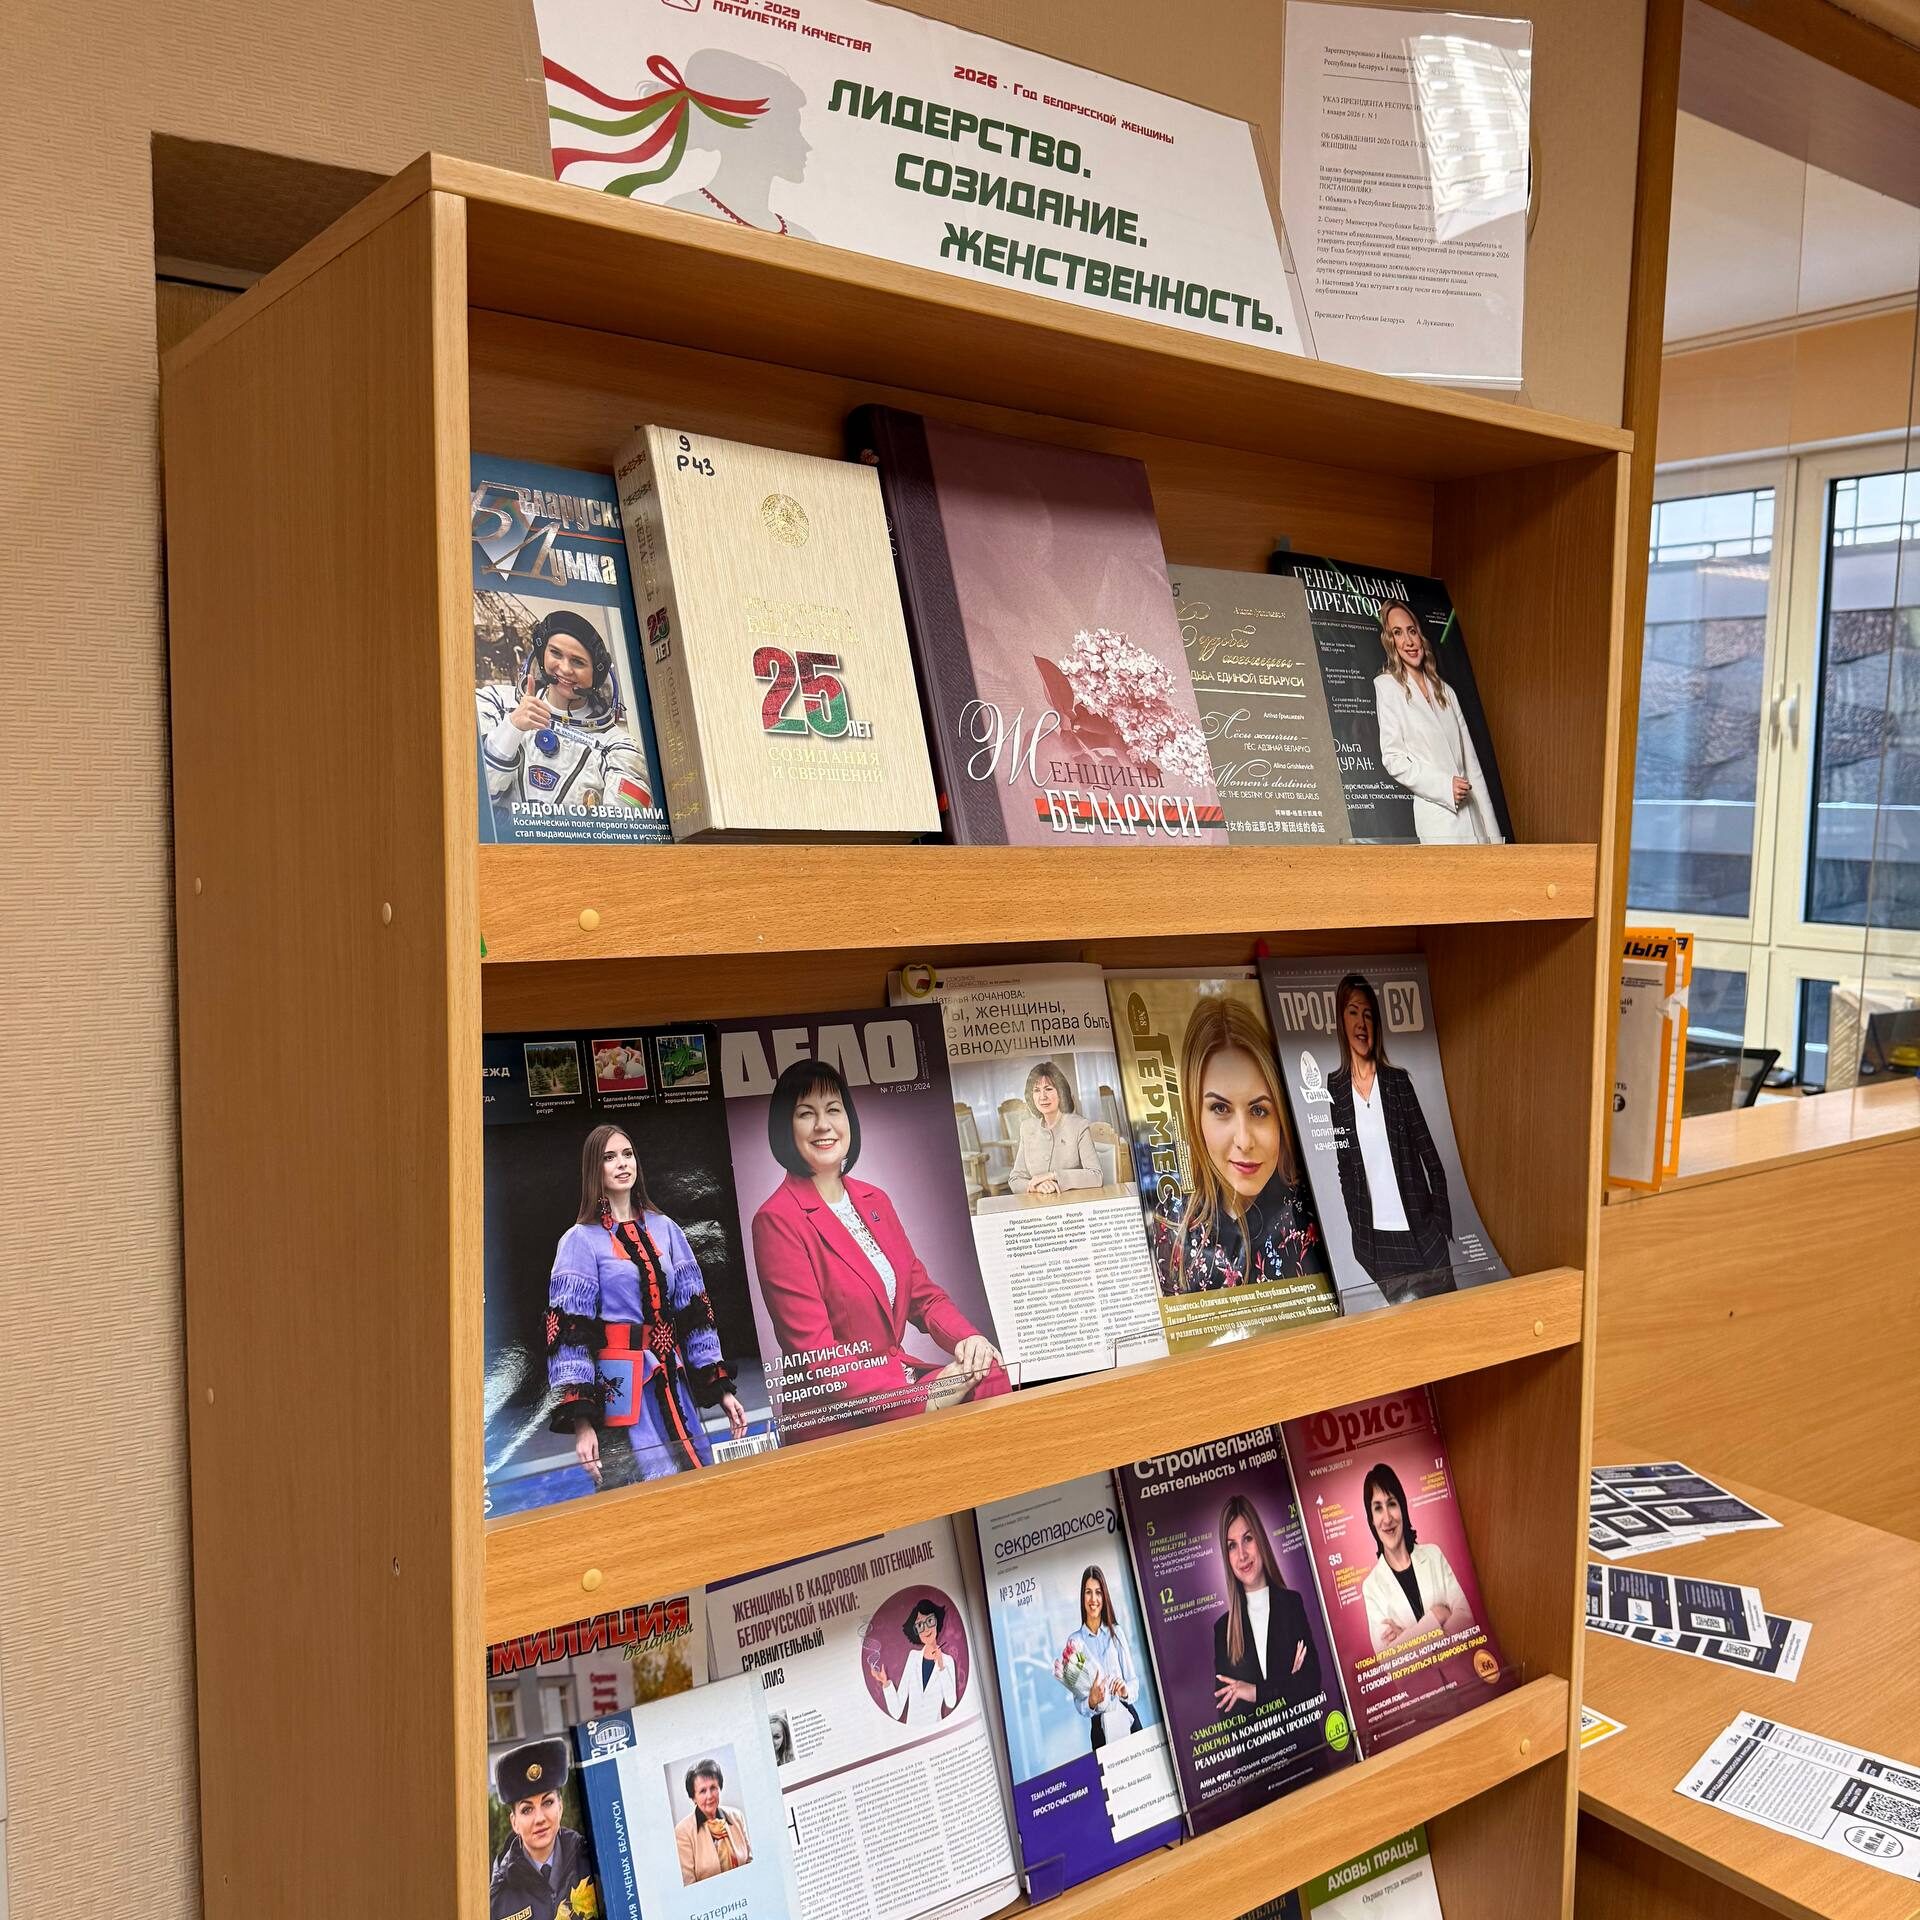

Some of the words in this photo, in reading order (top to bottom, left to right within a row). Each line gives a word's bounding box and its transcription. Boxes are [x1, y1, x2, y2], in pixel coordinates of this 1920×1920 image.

[763, 1, 800, 19] 2029
[713, 0, 797, 32] ПЯТИЛЕТКА
[801, 24, 872, 53] КАЧЕСТВА
[953, 65, 998, 89] 2026
[1042, 95, 1117, 126] БЕЛОРУССКОЙ
[1121, 119, 1174, 145] ЖЕНЩИНЫ
[1322, 96, 1340, 104] УКАЗ
[1341, 98, 1383, 109] ПРЕЗИДЕНТА
[828, 78, 1091, 179] ЛИДЕРСТВО.
[1321, 132, 1333, 140] ОБ
[1377, 137, 1391, 145] 2026
[1321, 141, 1357, 151] ЖЕНЩИНЫ
[895, 152, 1147, 248] СОЗИДАНИЕ.
[940, 221, 1283, 335] ЖЕНСТВЕННОСТЬ.
[679, 435, 691, 452] 9
[1293, 566, 1410, 602] ГЕНЕРАЛЬНЫЙ
[1216, 671, 1257, 685] ЕДИНОЙ
[1258, 673, 1305, 687] БЕЛАРУСИ
[751, 645, 848, 738] 25
[847, 718, 873, 739] ЛЕТ
[768, 746, 880, 767] СОЗИДАНИЯ
[786, 765, 885, 784] СВЕРШЕНИЙ
[1271, 777, 1318, 789] destinies
[1240, 791, 1264, 799] DESTINY
[1264, 791, 1274, 799] OF
[1275, 792, 1296, 800] UNITED
[1297, 793, 1320, 801] BELARUS
[511, 802, 566, 818] РЯДОМ
[569, 804, 586, 817] СО
[591, 806, 664, 821] ЗВЕЗДАМИ
[1043, 788, 1203, 838] БЕЛАРУСИ
[513, 817, 570, 828] Космический
[571, 819, 594, 828] полет
[596, 821, 628, 831] первого
[515, 830, 534, 838] стал
[535, 831, 592, 840] выдающимся
[593, 832, 632, 840] событием
[970, 989, 1026, 1002] КОЧАНОВА:
[1387, 987, 1417, 1026] BY
[976, 1000, 1066, 1020] женщины,
[963, 1019, 1026, 1038] имеем
[1030, 1015, 1080, 1034] права
[1083, 1011, 1111, 1029] быть
[719, 1019, 919, 1099] ДЕЛО
[896, 1085, 912, 1093] (337)
[913, 1082, 931, 1091] 2024
[1131, 1032, 1183, 1206] ГЕРМЕС
[1307, 1113, 1329, 1124] Наша
[1312, 1127, 1345, 1138] политика
[1314, 1138, 1350, 1152] качество!
[1290, 1282, 1316, 1295] Беларусь
[774, 1340, 873, 1371] ЛАПАТИНСКАЯ:
[765, 1371, 805, 1389] отаем
[806, 1370, 814, 1381] с
[815, 1354, 889, 1381] педагогами
[776, 1380, 848, 1404] педагогов»
[827, 1396, 869, 1411] учреждения
[868, 1384, 923, 1403] дополнительного
[817, 1410, 852, 1423] областной
[853, 1404, 881, 1418] институт
[882, 1398, 911, 1412] развития
[1301, 1396, 1422, 1452] Юрист
[1133, 1426, 1274, 1479] Строительная
[1140, 1463, 1236, 1498] деятельность
[1239, 1458, 1248, 1470] и
[1249, 1448, 1277, 1469] право
[994, 1508, 1105, 1559] секретарское
[1146, 1521, 1156, 1537] 5
[732, 1586, 794, 1624] ЖЕНЩИНЫ
[796, 1582, 806, 1601] В
[806, 1562, 869, 1600] КАДРОВОМ
[870, 1540, 935, 1579] ПОТЕНЦИАЛЕ
[1015, 1577, 1036, 1597] 2025
[1017, 1594, 1033, 1608] март
[1159, 1587, 1175, 1604] 12
[737, 1601, 817, 1649] БЕЛОРУССКОЙ
[817, 1591, 861, 1621] НАУКИ:
[489, 1596, 690, 1678] МИЛИЦИЯ
[622, 1622, 695, 1662] Беларуси
[741, 1628, 826, 1673] СРАВНИТЕЛЬНЫЙ
[1357, 1674, 1362, 1683] В
[1362, 1662, 1391, 1681] РАЗВИТИИ
[1391, 1652, 1419, 1668] БИЗНЕСА,
[1419, 1637, 1451, 1657] НОТАРИАТУ
[1451, 1624, 1481, 1642] ПРИДЕТСЯ
[1355, 1658, 1376, 1671] ЧТОБЫ
[1360, 1685, 1366, 1695] С
[1365, 1672, 1393, 1693] ГОЛОВОЙ
[1392, 1657, 1433, 1682] ПОГРУЗИТЬСЯ
[1432, 1655, 1438, 1664] В
[1438, 1643, 1468, 1662] ЦИФРОВОЕ
[1468, 1634, 1488, 1649] ПРАВО
[1255, 1696, 1287, 1717] ОСНОВА
[1366, 1698, 1392, 1715] АНАСТАСИЯ
[1192, 1734, 1231, 1758] ДОВЕРИЯ
[1231, 1731, 1238, 1743] К
[1239, 1715, 1282, 1739] КОМПАНИИ
[1281, 1710, 1289, 1721] И
[1288, 1692, 1327, 1718] УСПЕШНОЙ
[1194, 1745, 1246, 1771] РЕАЛИЗАЦИИ
[1246, 1726, 1286, 1751] СЛОЖНЫХ
[1030, 1790, 1046, 1802] ТЕМА
[1045, 1780, 1068, 1796] НОМЕРА:
[1200, 1779, 1217, 1790] АННА
[1222, 1779, 1236, 1792] ОАО
[1033, 1801, 1056, 1818] ПРОСТО
[1055, 1786, 1089, 1808] СЧАСТЛИВАЯ
[611, 1800, 628, 1854] БЕЛАРУСИ
[1328, 1859, 1372, 1891] АХОВЫ
[1373, 1836, 1419, 1870] ПРАЦЫ
[619, 1857, 637, 1901] УЧЕНЫХ
[690, 1896, 749, 1920] Екатерина
